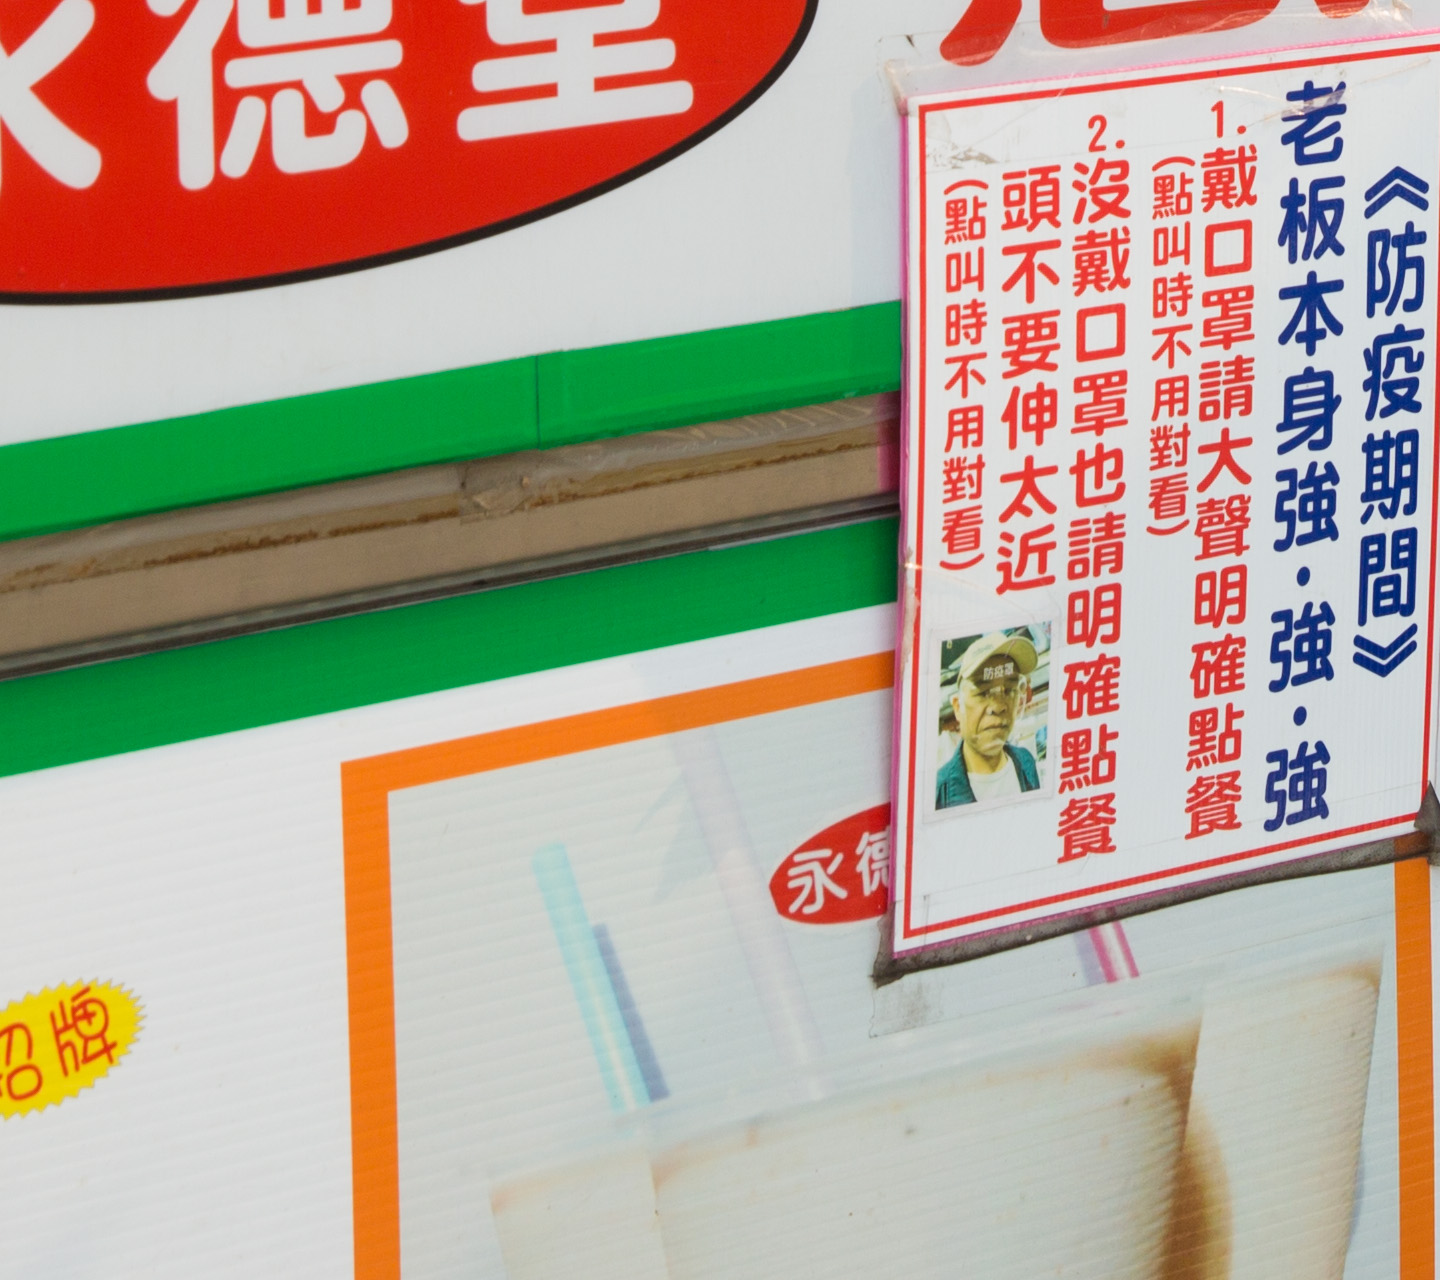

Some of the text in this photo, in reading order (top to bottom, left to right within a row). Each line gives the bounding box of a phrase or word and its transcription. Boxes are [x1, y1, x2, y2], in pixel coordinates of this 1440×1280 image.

[996, 165, 1063, 595] 頭不要伸太近
